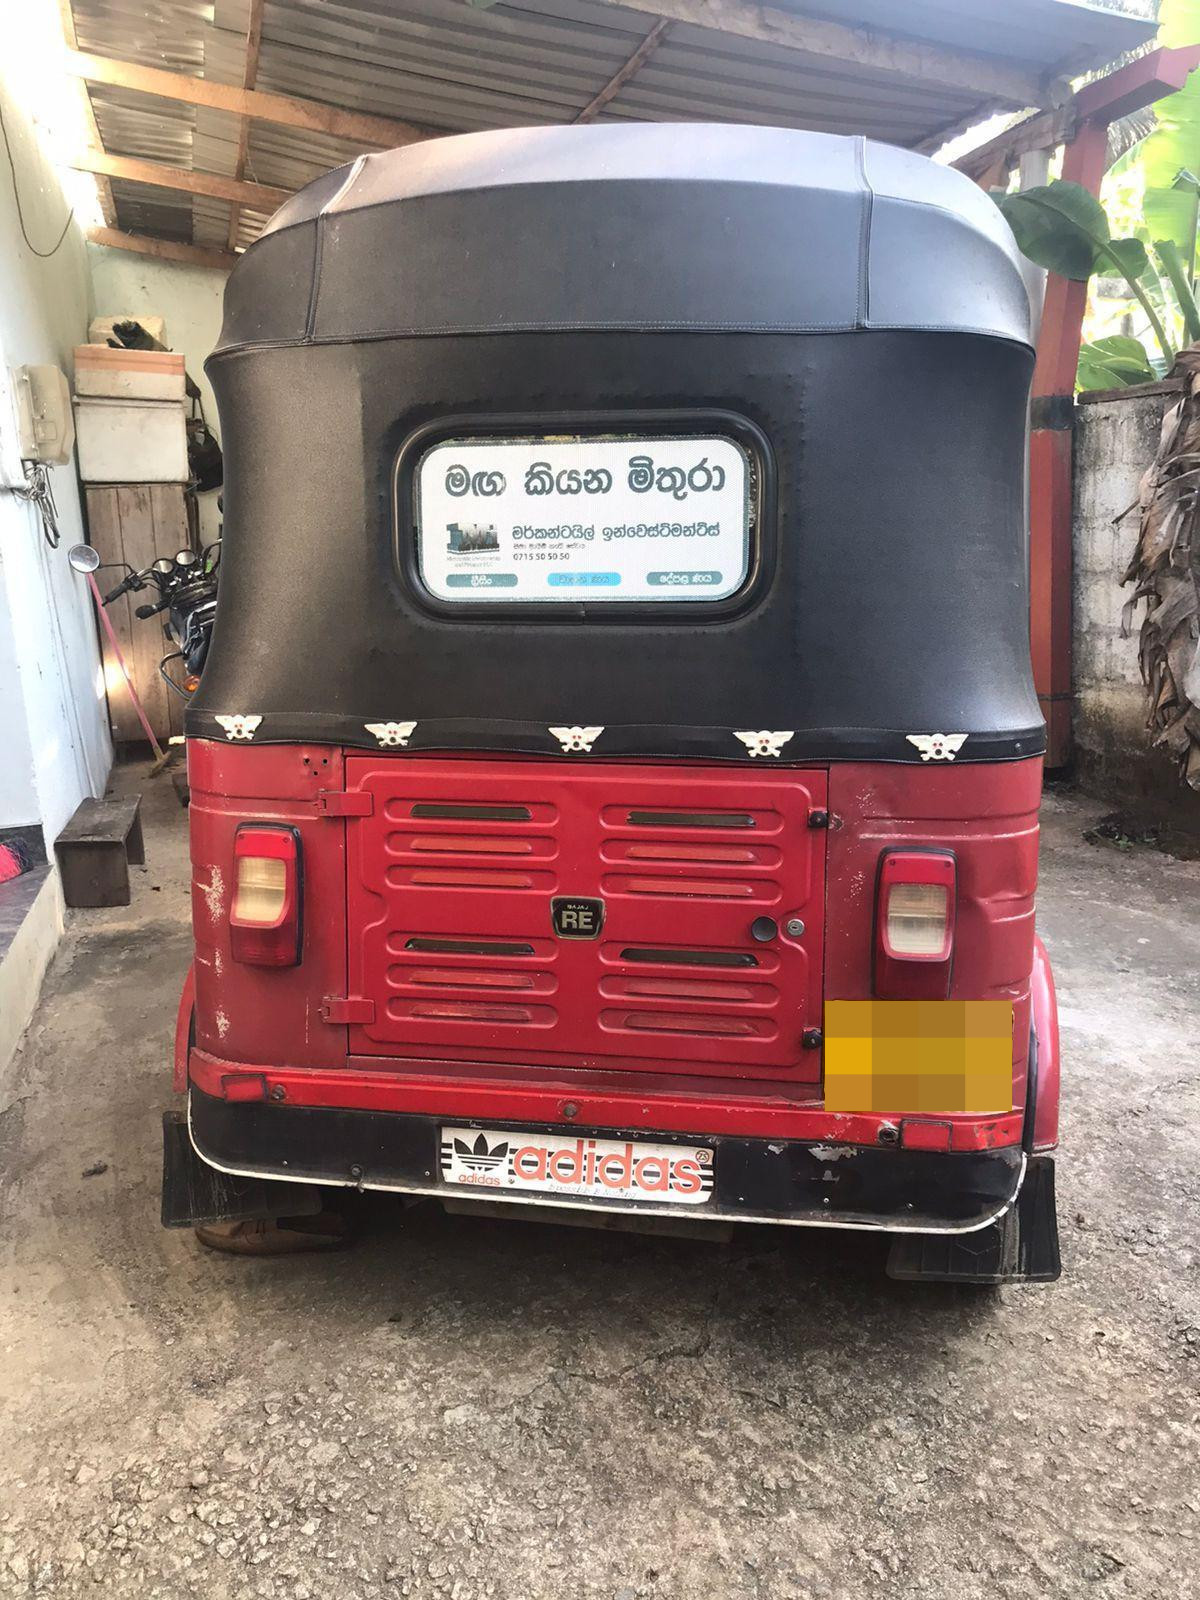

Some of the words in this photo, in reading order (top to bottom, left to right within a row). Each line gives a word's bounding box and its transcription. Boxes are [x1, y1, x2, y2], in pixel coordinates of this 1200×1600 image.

[445, 464, 506, 497] මඟ
[524, 461, 613, 496] කියන
[628, 455, 725, 500] මිතුරා
[513, 553, 534, 561] 0715
[535, 553, 546, 561] 50
[547, 553, 558, 561] 50
[559, 552, 570, 560] 50
[561, 910, 594, 930] RE
[513, 1139, 702, 1194] adidas
[458, 1172, 501, 1186] adidas
